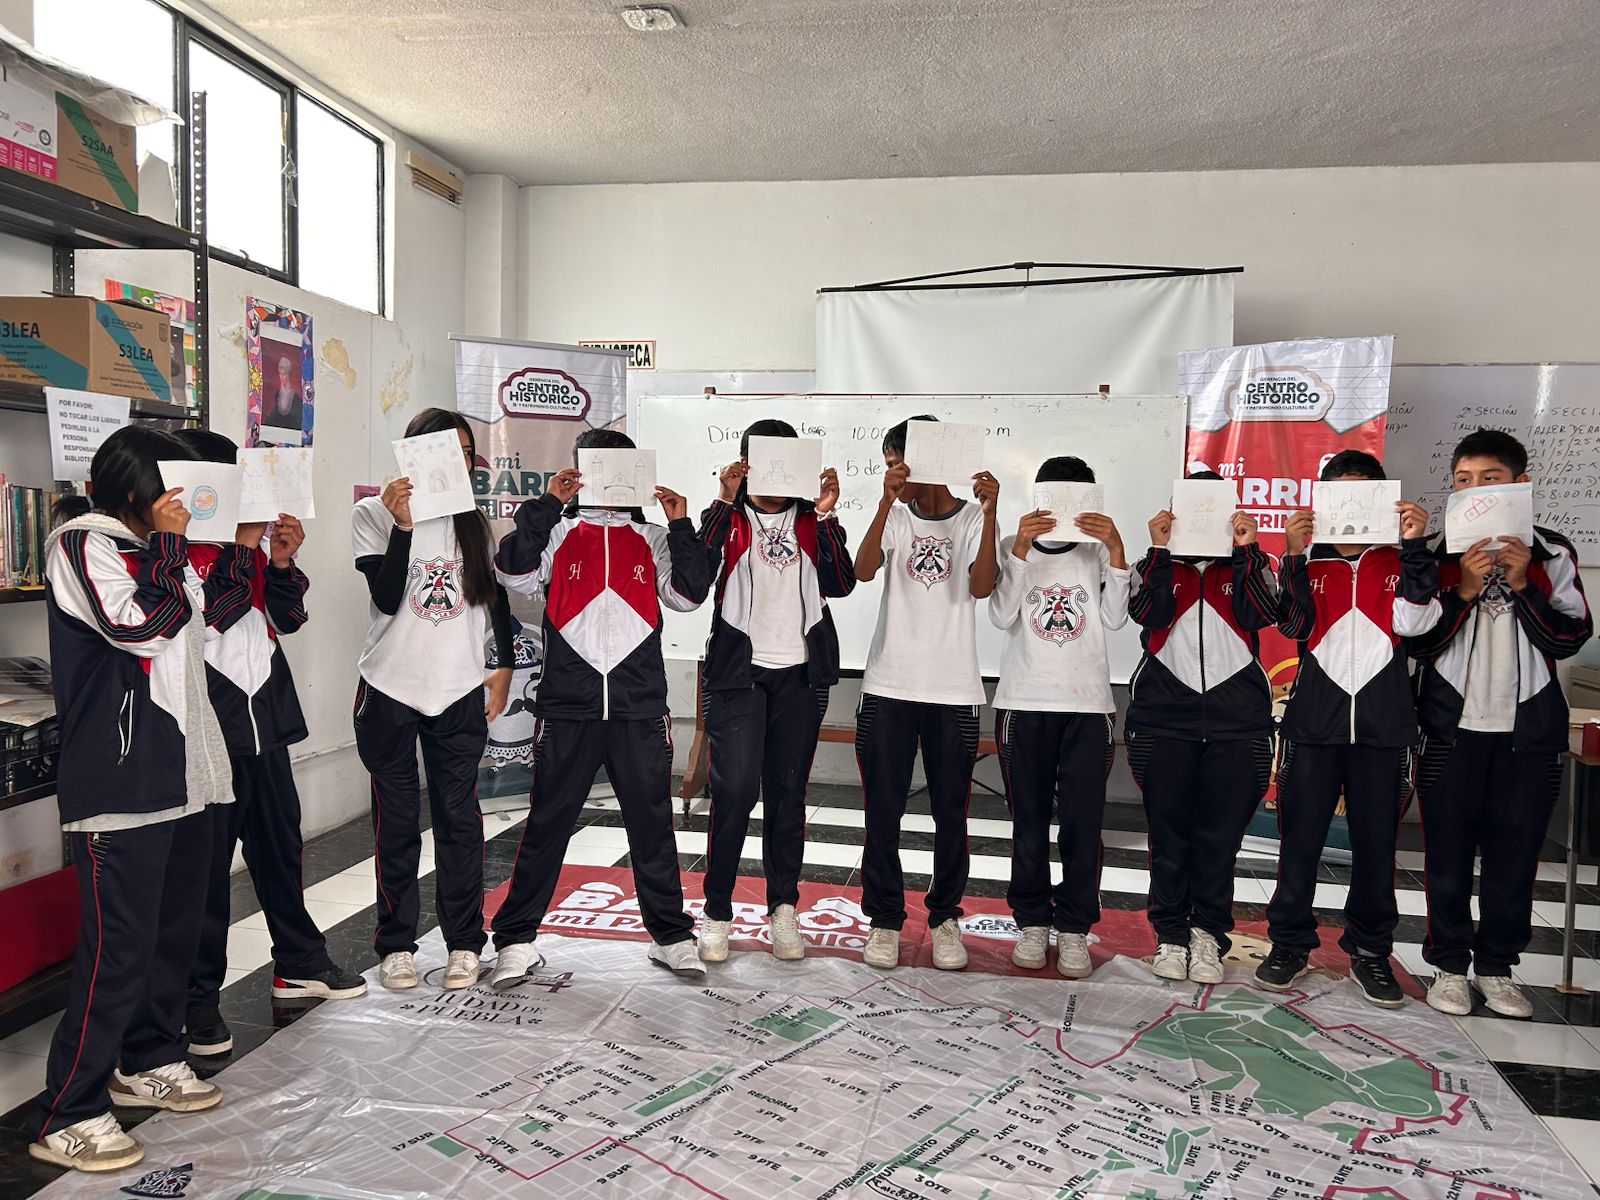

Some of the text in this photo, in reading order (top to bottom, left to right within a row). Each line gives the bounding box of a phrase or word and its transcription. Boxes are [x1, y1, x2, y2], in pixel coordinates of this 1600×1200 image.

[82, 135, 114, 157] S2SAA
[0, 322, 41, 339] 3LEA
[119, 343, 154, 363] S3LEA
[516, 381, 570, 396] CENTRO
[1245, 382, 1309, 394] CENTRO
[58, 399, 94, 410] POR FAVOR:
[1389, 402, 1414, 414] CIÓN
[1475, 405, 1518, 416] SECCIÓN
[1551, 407, 1600, 417] SECCI
[69, 412, 88, 420] TOCAR
[101, 417, 121, 425] LIBROS
[62, 434, 88, 442] PERSONA
[494, 452, 522, 470] mi
[845, 458, 882, 477] 5 de
[1218, 457, 1245, 477] mi
[1236, 478, 1313, 506] RRI
[568, 560, 647, 584] H R
[1309, 574, 1400, 595] H R
[547, 913, 603, 927] mi
[417, 1004, 522, 1026] PUEBLA
[1019, 1015, 1041, 1025] PTE
[604, 1041, 619, 1051] AV
[623, 1051, 643, 1062] PTE
[950, 1043, 972, 1054] PTE
[1040, 1046, 1060, 1060] PTE
[593, 1067, 632, 1086] JUÁREZ
[490, 1081, 513, 1093] SUR
[823, 1076, 838, 1085] AV
[847, 1084, 869, 1097] PTE
[1051, 1087, 1076, 1102] OTE
[747, 1089, 799, 1113] REFORMA
[1050, 1098, 1076, 1111] OTE
[1127, 1098, 1151, 1112] OTE
[763, 1110, 787, 1123] PTE
[914, 1103, 934, 1118] NTE
[1005, 1107, 1044, 1125] 12 OTE
[1063, 1122, 1081, 1136] NTE
[1130, 1120, 1168, 1137] CENTRAL
[1351, 1114, 1378, 1126] OTE
[740, 1133, 765, 1145] PTE
[1000, 1123, 1019, 1137] NTE
[1081, 1119, 1160, 1150] SEGUNDA CENTRAL
[1124, 1126, 1166, 1145] 16 OTE
[1263, 1123, 1290, 1141] OTE
[391, 1131, 435, 1152] 17 SUR
[530, 1138, 564, 1159] 19 PTE
[669, 1135, 720, 1159] AV 11 PTE
[917, 1127, 980, 1172] AYUNTAMIENTO
[1021, 1139, 1049, 1155] OTE
[1055, 1138, 1098, 1161] 10 OTE
[1222, 1137, 1271, 1155] 22 OTE
[583, 1154, 597, 1162] 11
[596, 1142, 620, 1157] SUR
[805, 1145, 829, 1158] PTE
[1086, 1137, 1165, 1167] PRIMERA CENTRAL
[1184, 1144, 1202, 1167] 10 OTE
[1208, 1142, 1258, 1161] 20 OTE
[1292, 1142, 1342, 1161] 24 OTE
[758, 1157, 781, 1171] PTE
[870, 1138, 938, 1186] AYUNTAMIENTO
[989, 1154, 1016, 1171] OTE
[1016, 1154, 1055, 1174] 6 OTE
[1227, 1160, 1251, 1182] 14 NTE
[1351, 1159, 1404, 1176] 24 OTE
[1412, 1157, 1432, 1178] 20 NTE
[597, 1163, 633, 1185] 9 SUR
[1065, 1175, 1085, 1191] NTE
[1197, 1170, 1222, 1192] 16 OTE
[1264, 1169, 1316, 1189] 18 OTE
[1332, 1164, 1354, 1186] 18 NTE
[914, 1174, 952, 1195] 3 OTE
[1271, 1186, 1288, 1200] NTE
[1446, 1177, 1466, 1200] 22 NTE
[1510, 1187, 1544, 1199] OTE
